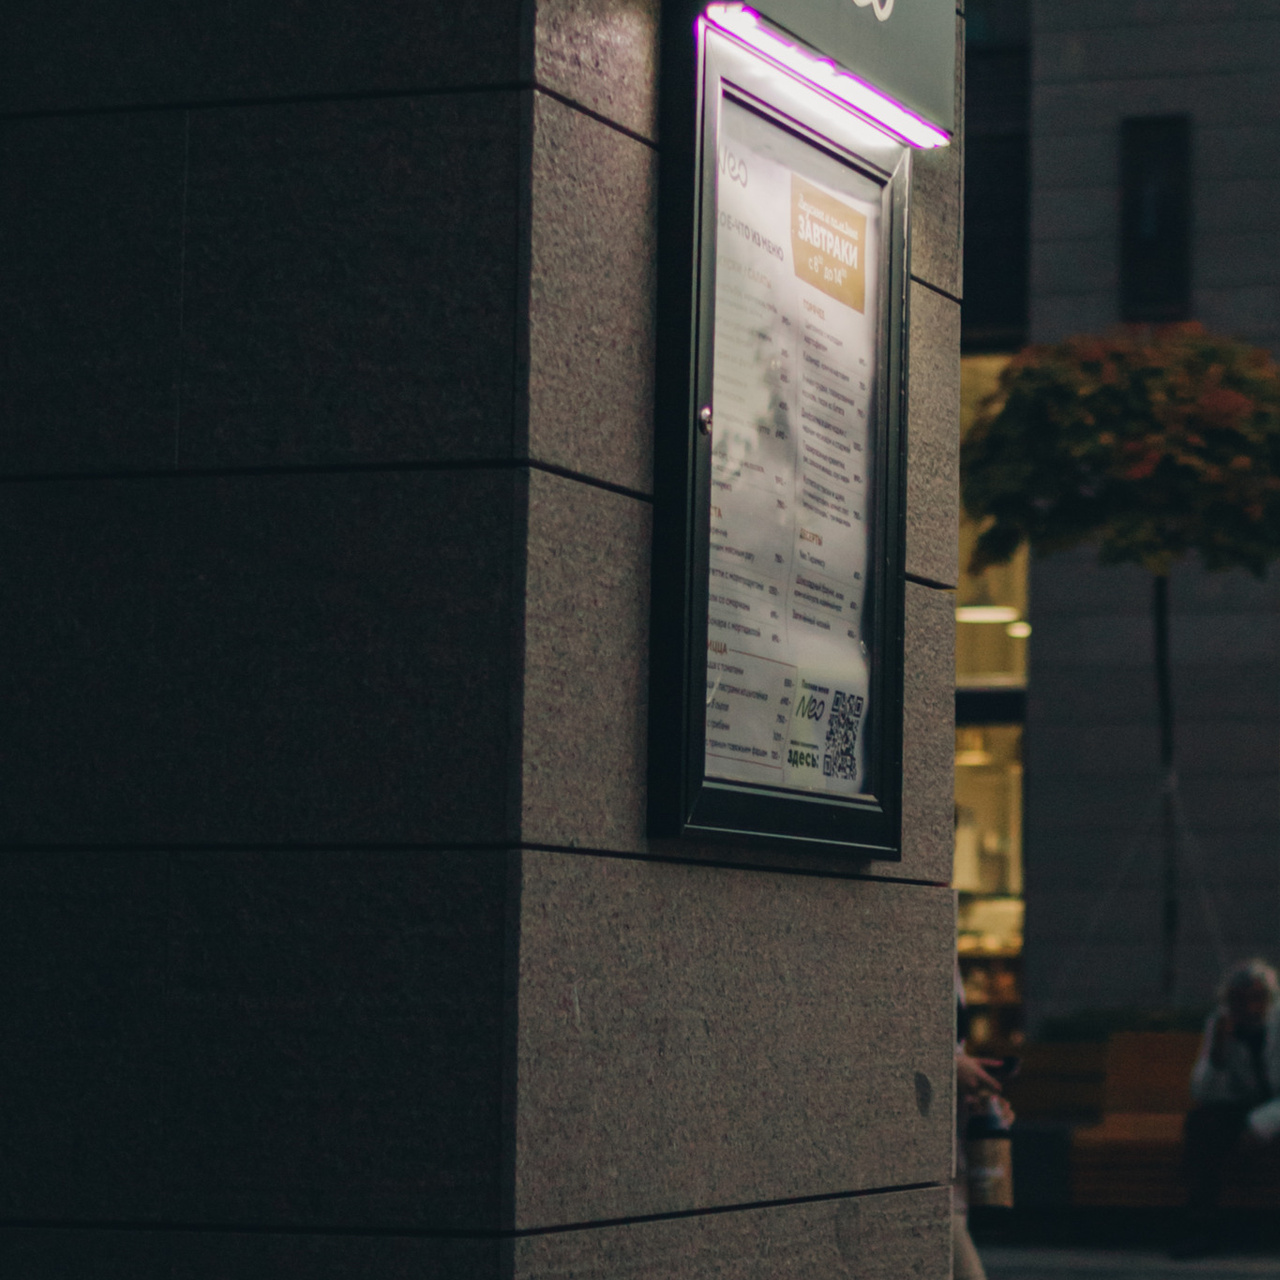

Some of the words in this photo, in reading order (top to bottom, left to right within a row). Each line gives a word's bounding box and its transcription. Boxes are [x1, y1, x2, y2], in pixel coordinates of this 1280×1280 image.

[718, 211, 750, 240] ОЕ-ЧТО
[762, 235, 784, 262] МЕНЮ
[798, 213, 858, 271] ЗАВТРАКИ
[709, 639, 728, 655] ИЦЦА
[795, 694, 825, 721] Neo
[787, 749, 819, 768] здесь:
